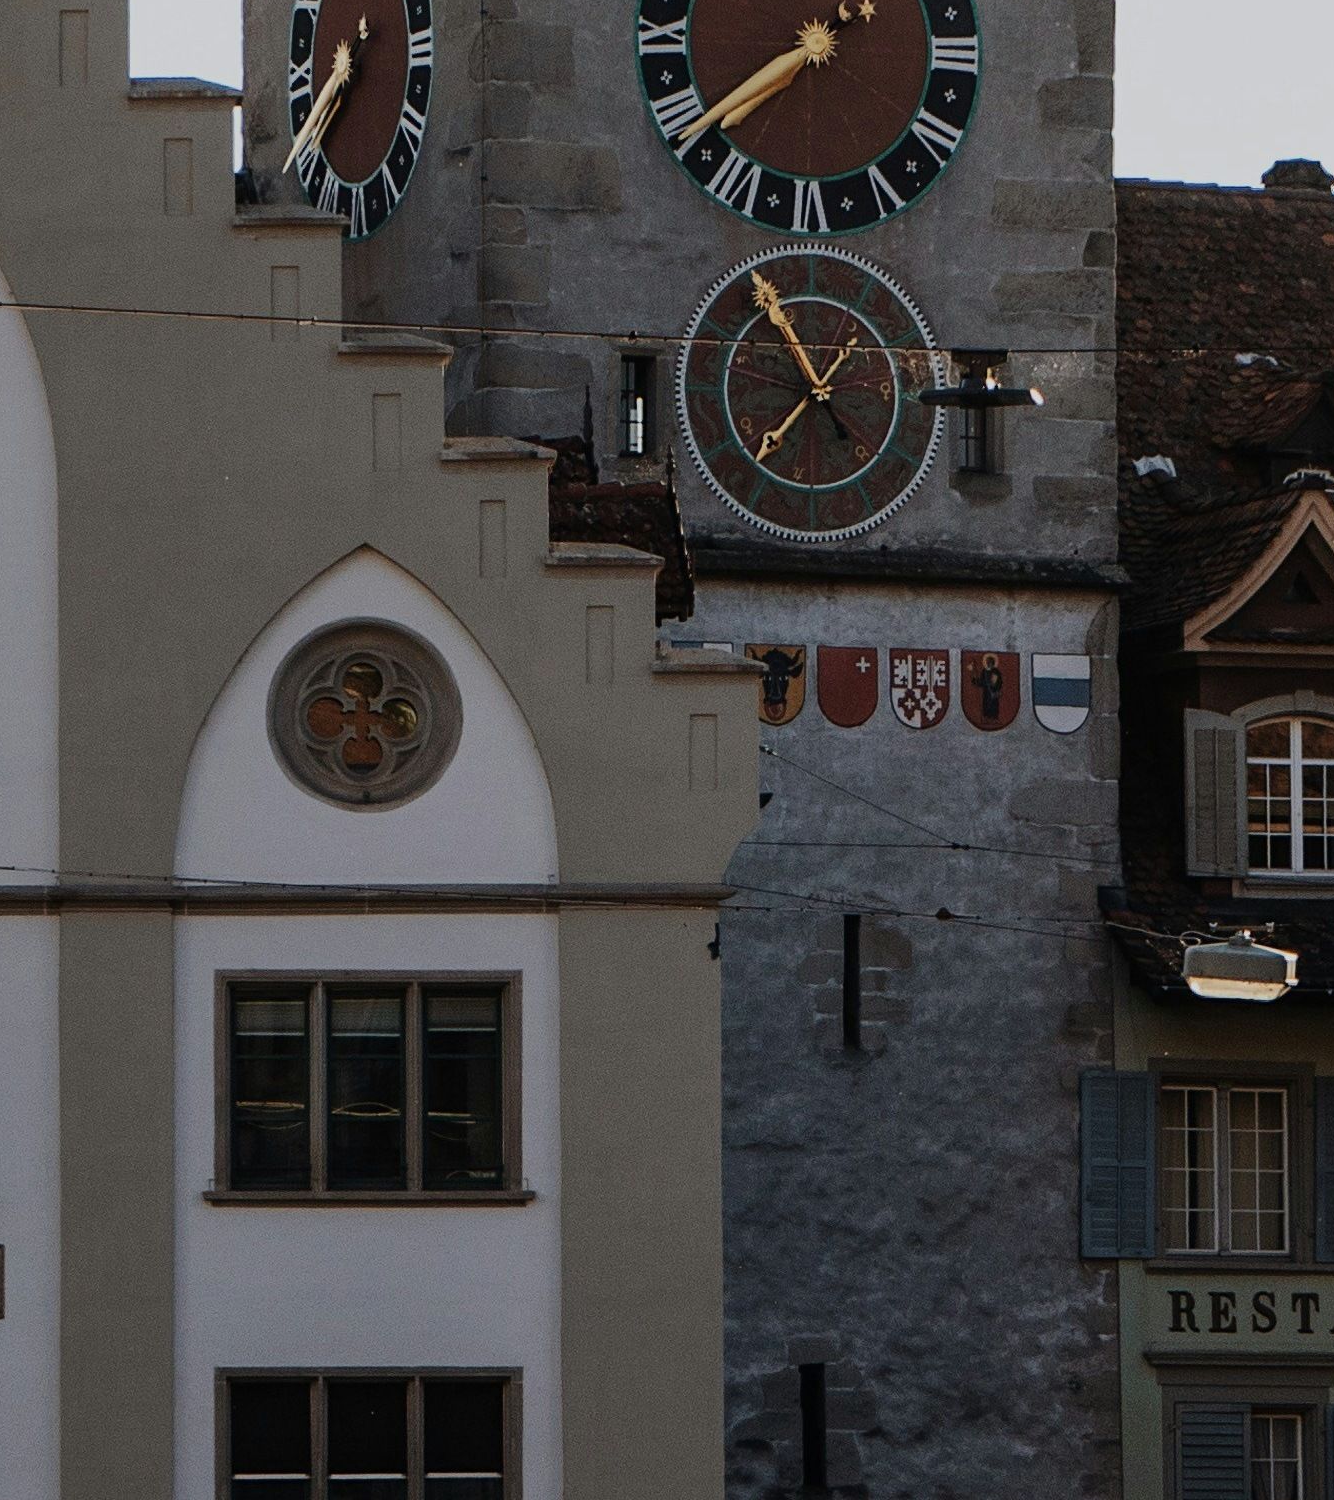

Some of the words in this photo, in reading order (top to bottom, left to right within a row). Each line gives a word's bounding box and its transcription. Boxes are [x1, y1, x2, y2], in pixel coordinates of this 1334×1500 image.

[638, 16, 687, 56] IX
[931, 34, 979, 75] III
[912, 107, 964, 168] IV
[705, 148, 762, 218] VII
[791, 179, 831, 233] VI
[867, 164, 906, 219] V
